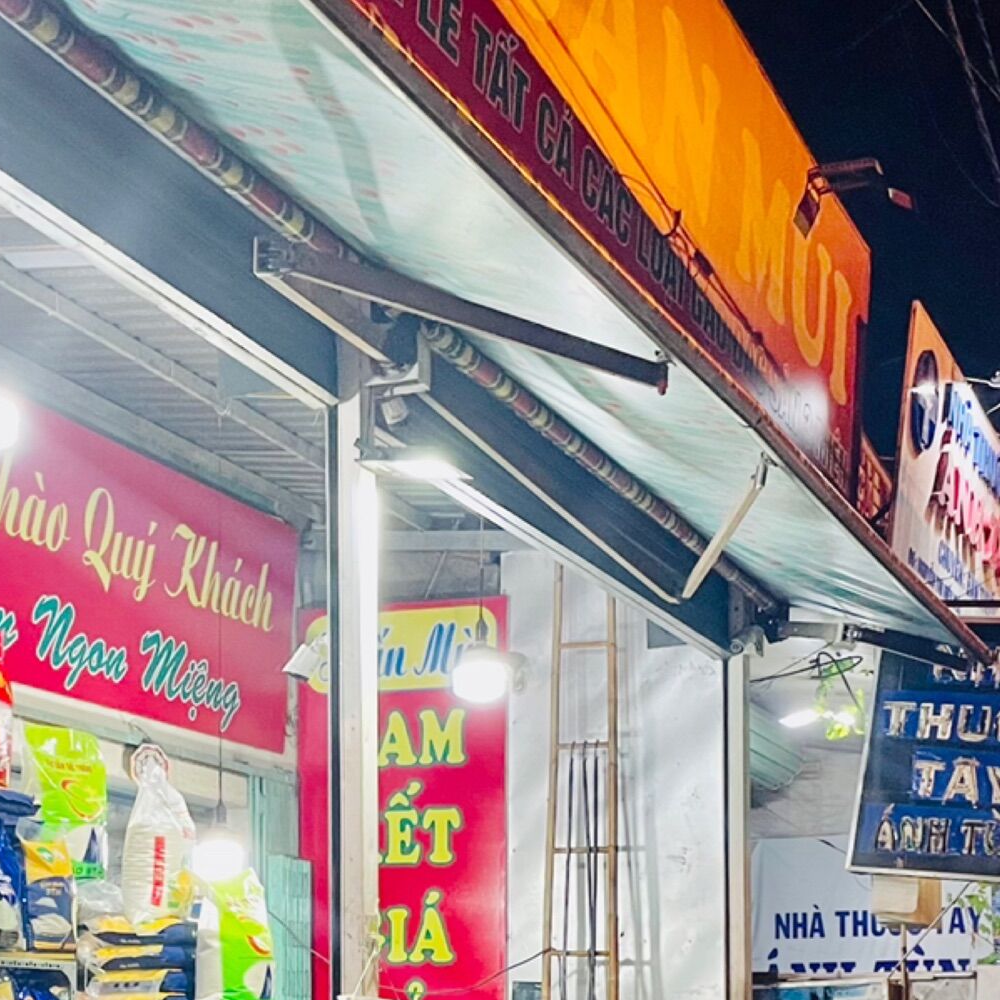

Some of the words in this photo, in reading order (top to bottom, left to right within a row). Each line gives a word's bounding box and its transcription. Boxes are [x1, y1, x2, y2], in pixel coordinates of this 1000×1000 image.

[82, 486, 157, 602] Quý
[163, 522, 274, 632] Khách
[33, 594, 129, 691] Ngon
[140, 630, 242, 732] Miệng
[378, 708, 468, 768] AM
[883, 700, 1000, 744] THU
[377, 781, 464, 866] ẾT
[774, 904, 825, 940] NHÀ
